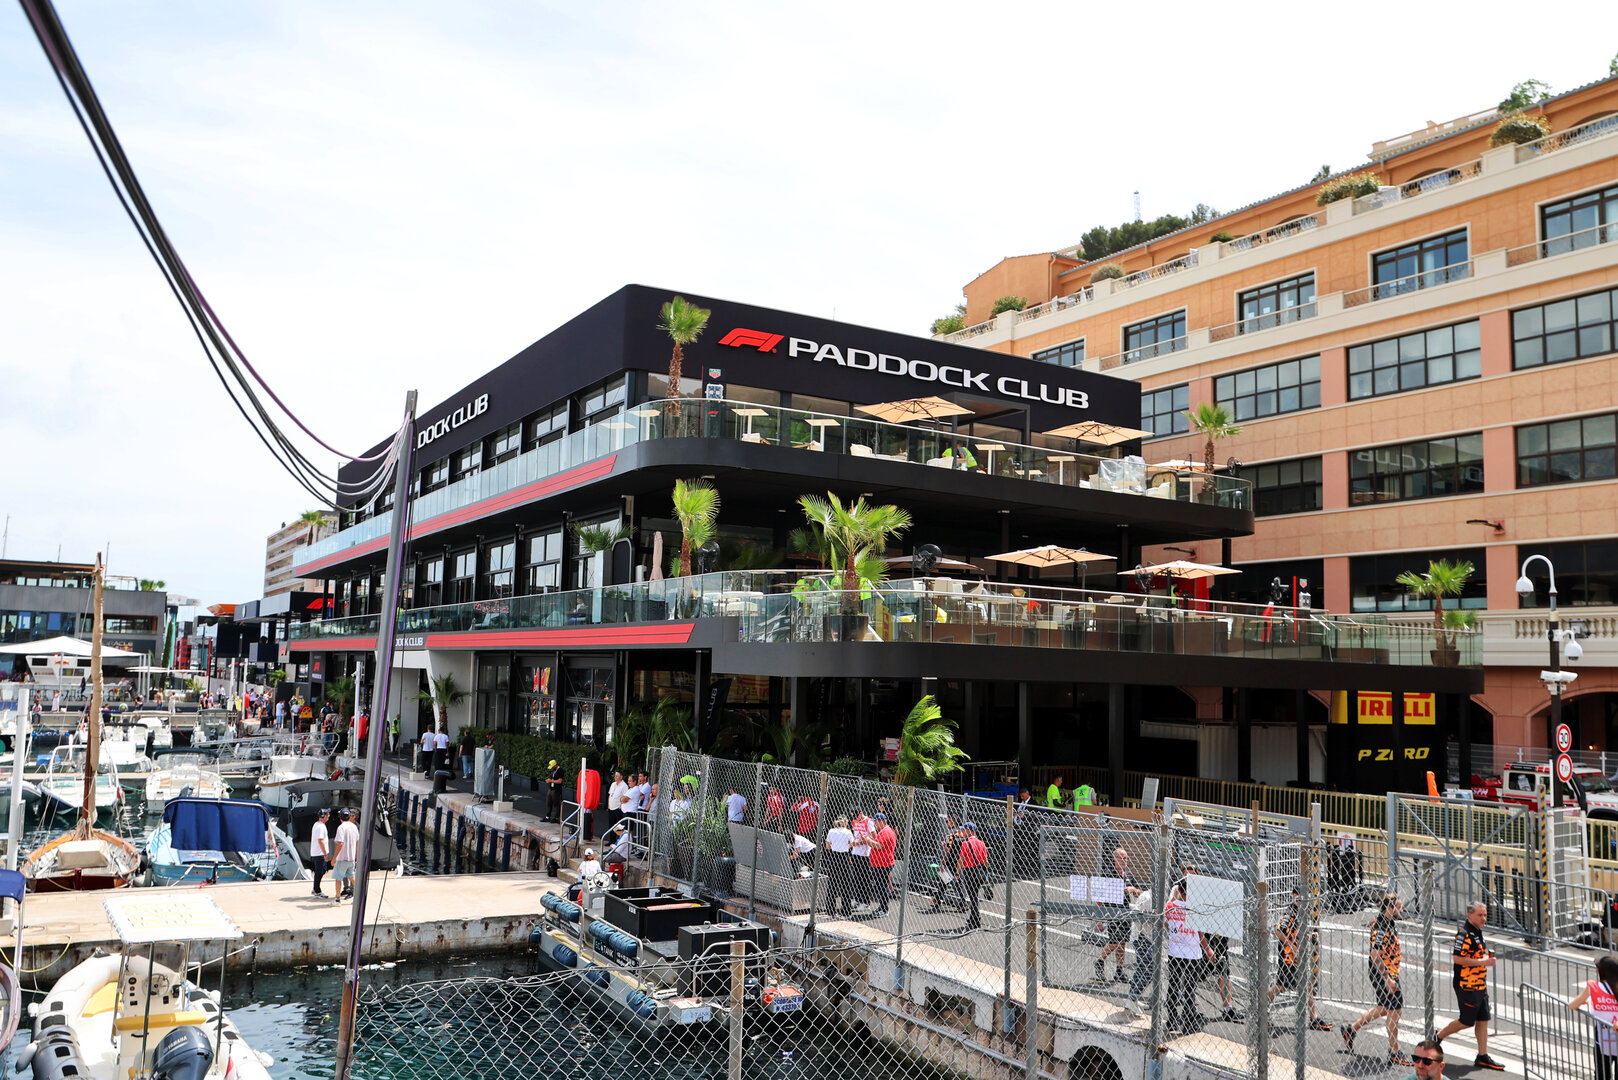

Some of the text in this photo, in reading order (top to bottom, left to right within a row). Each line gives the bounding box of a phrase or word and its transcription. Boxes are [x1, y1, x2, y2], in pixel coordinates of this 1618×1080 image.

[788, 336, 990, 392] PADDOCK
[997, 376, 1090, 410] CLUB
[417, 393, 489, 449] DOCK CLUB
[395, 637, 409, 647] DOCK
[1359, 699, 1431, 718] IRLLI
[1560, 732, 1568, 745] 30
[1357, 748, 1372, 762] P
[1596, 996, 1617, 1004] SÉCU
